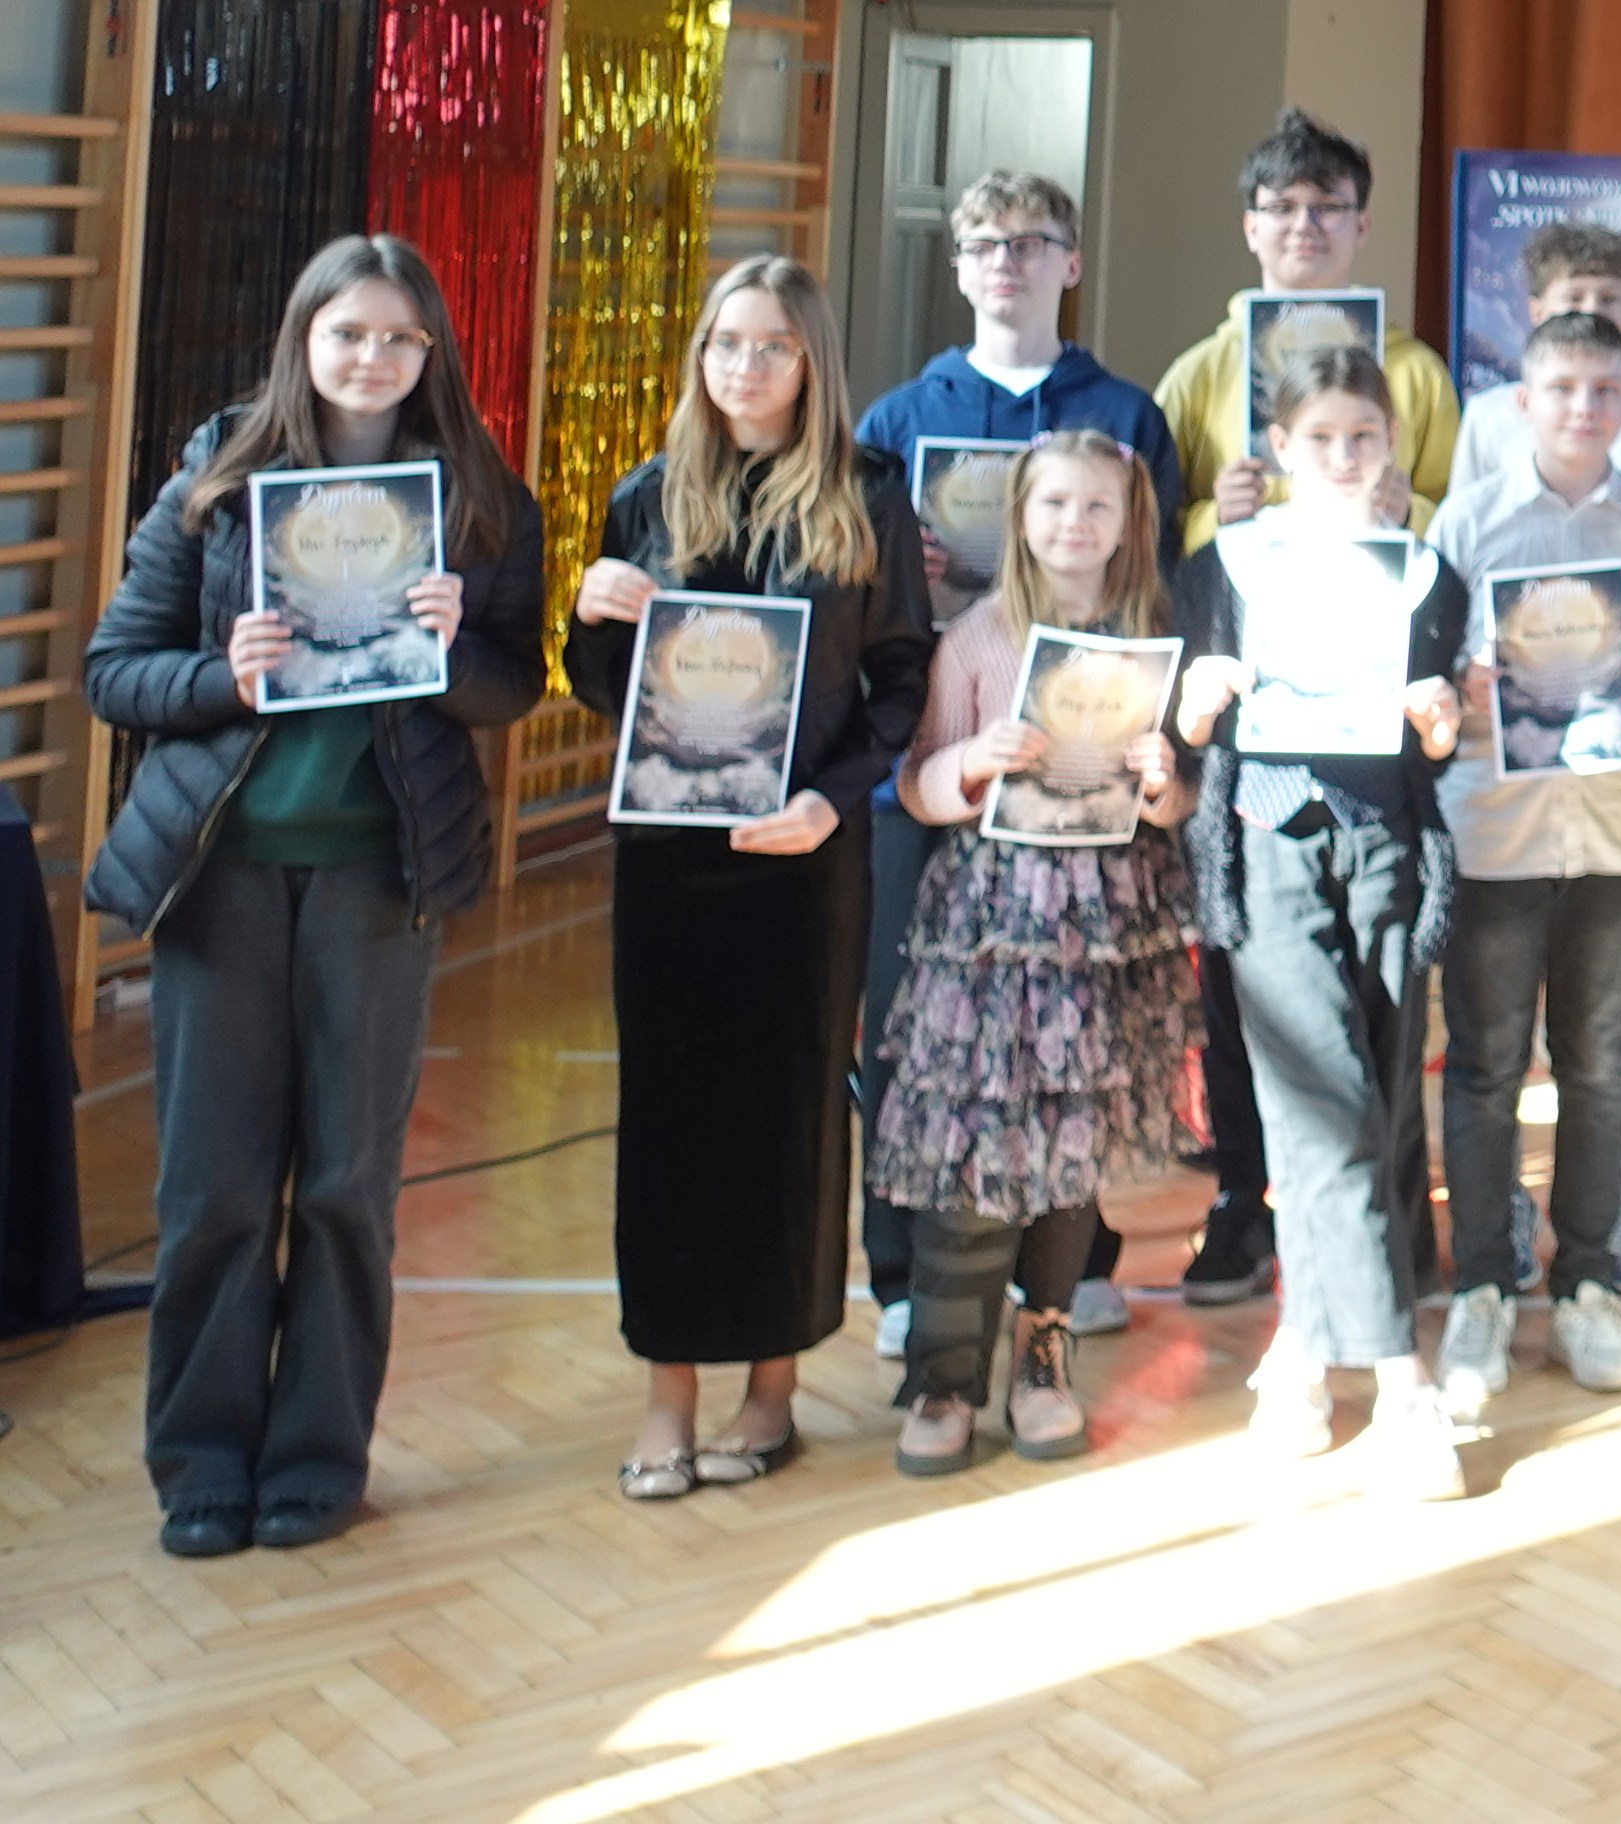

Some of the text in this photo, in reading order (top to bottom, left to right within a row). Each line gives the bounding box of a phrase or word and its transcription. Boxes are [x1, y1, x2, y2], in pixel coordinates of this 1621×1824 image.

[1488, 168, 1519, 199] VI
[294, 481, 388, 520] Dyplom
[682, 604, 763, 642] Dyplom
